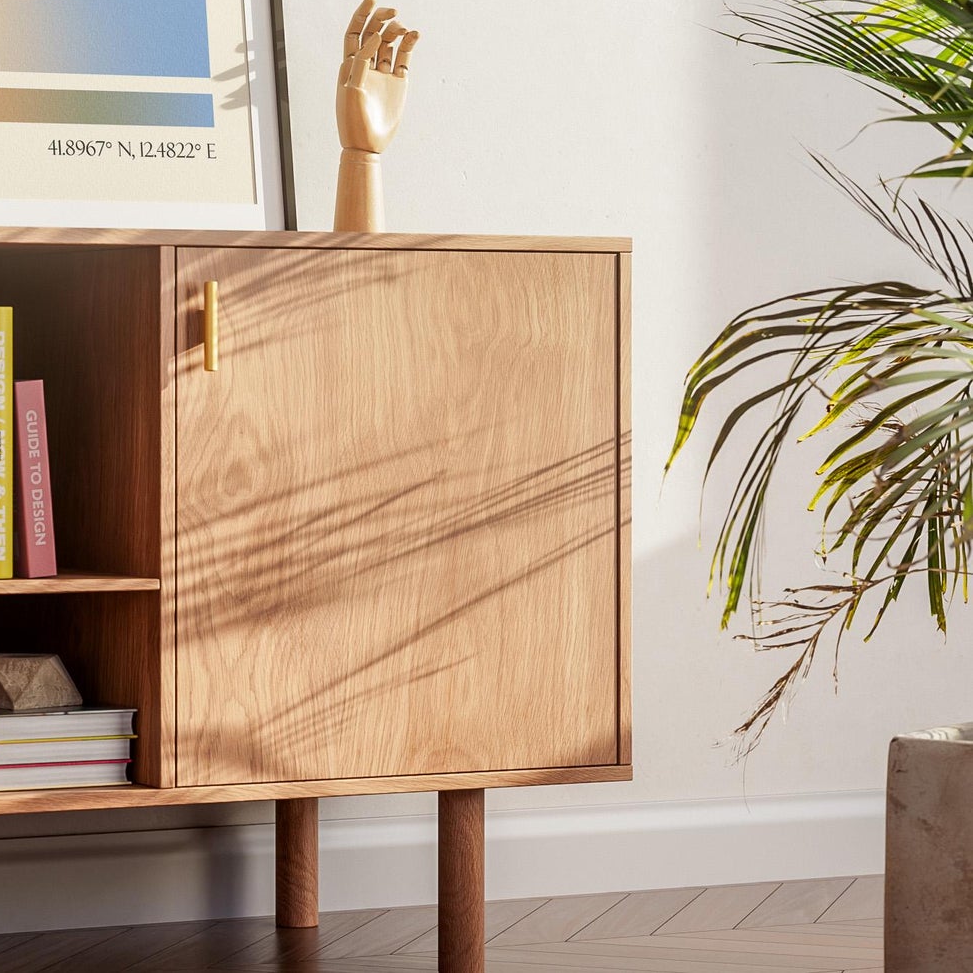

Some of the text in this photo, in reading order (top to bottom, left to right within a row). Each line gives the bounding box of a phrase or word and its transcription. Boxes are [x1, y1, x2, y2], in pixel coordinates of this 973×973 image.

[47, 139, 217, 160] 41.8967° N, 12.4822° E
[26, 409, 46, 546] GUIDE TO DESIGN
